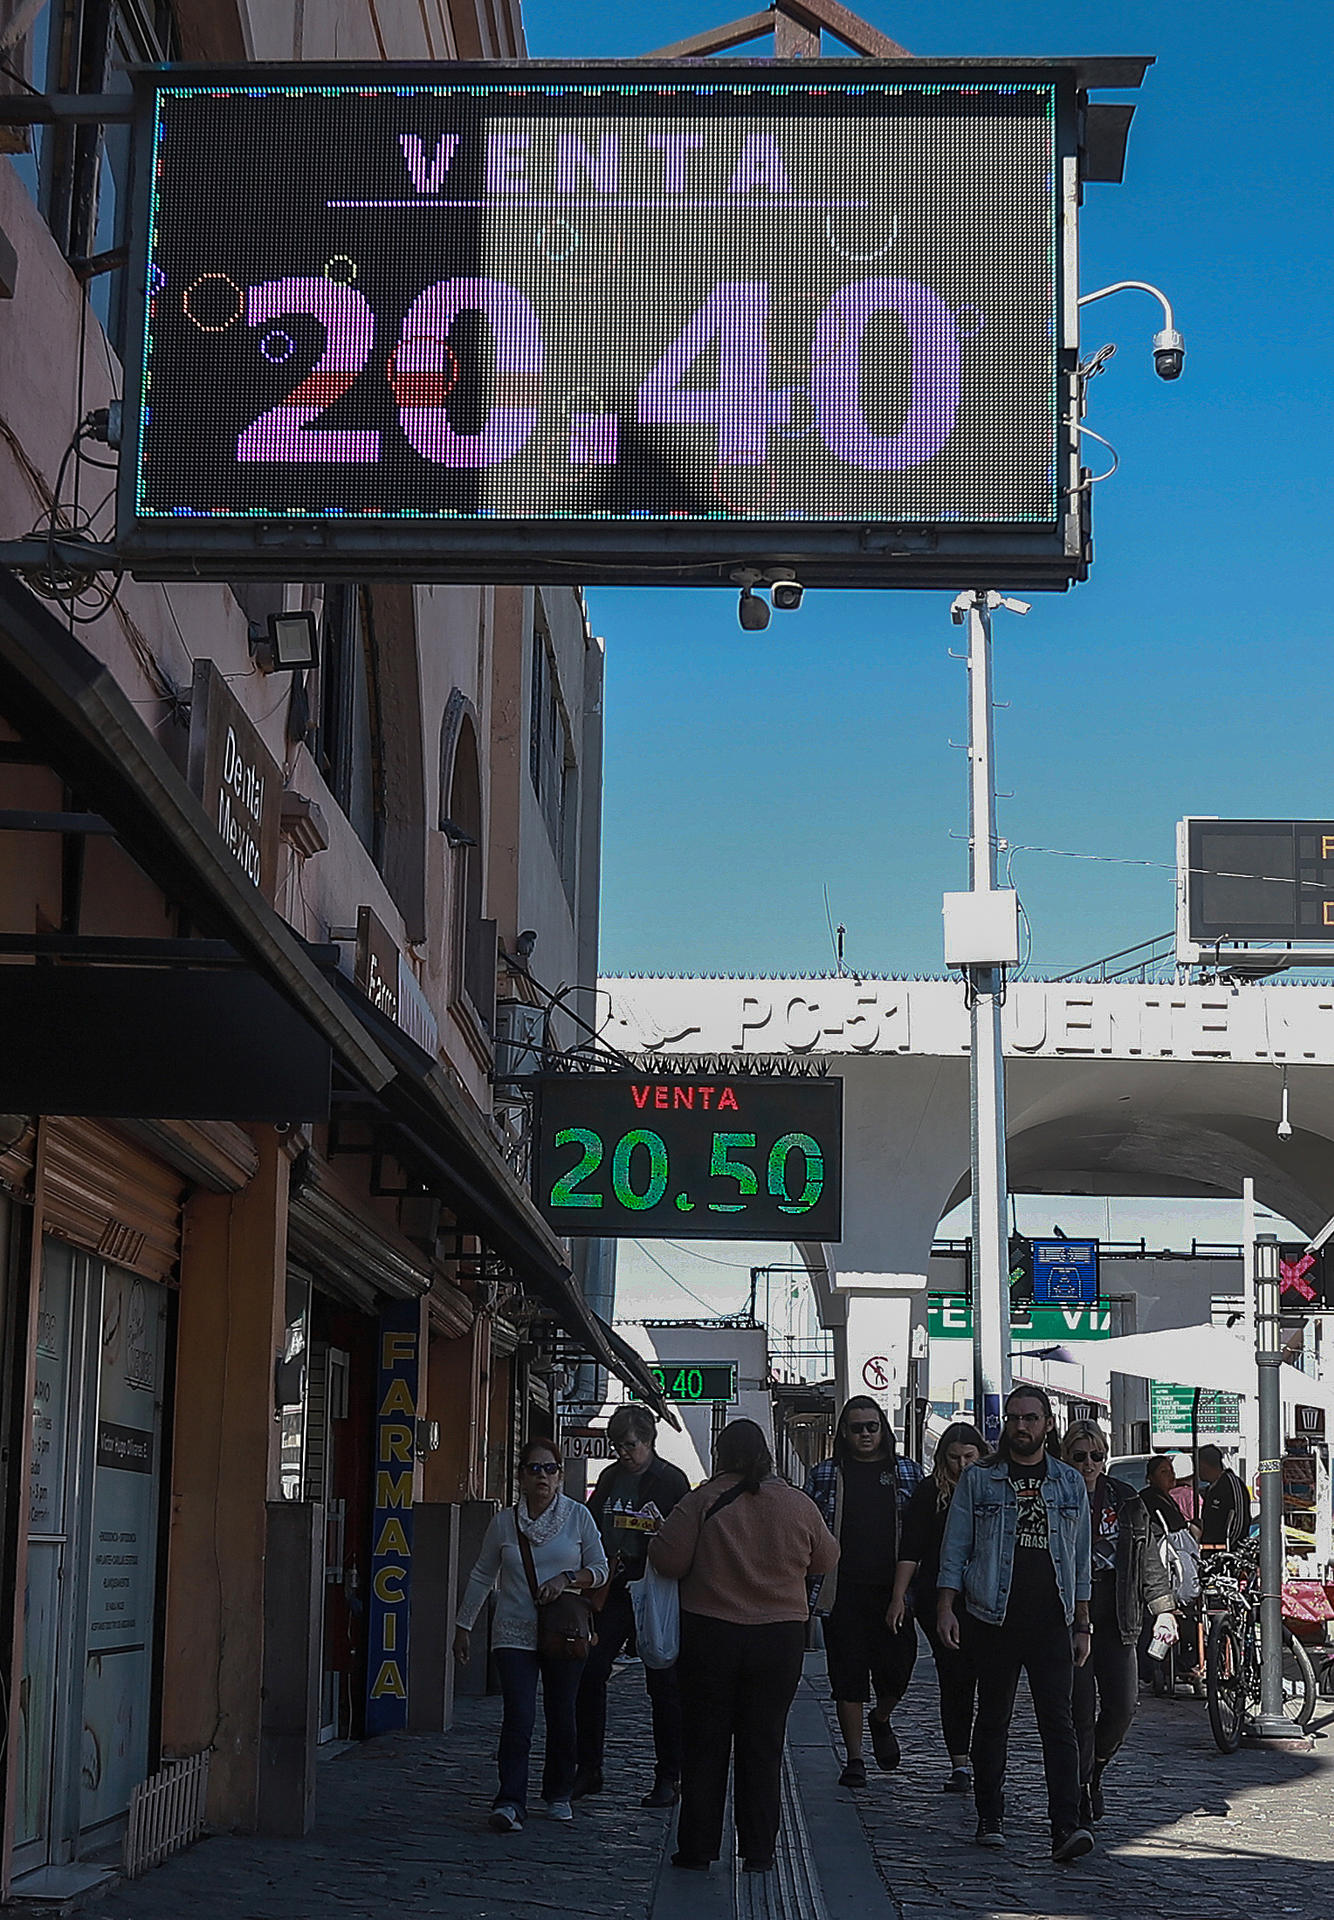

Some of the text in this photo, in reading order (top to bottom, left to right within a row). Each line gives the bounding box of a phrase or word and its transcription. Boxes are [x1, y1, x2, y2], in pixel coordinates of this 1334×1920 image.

[399, 133, 795, 196] VENTA
[236, 276, 963, 470] 20.40
[223, 724, 265, 826] Dental
[959, 990, 1232, 1057] UENTE
[630, 1085, 740, 1111] VENTA
[549, 1126, 825, 1215] 20.50
[369, 1330, 418, 1700] FARMACIA
